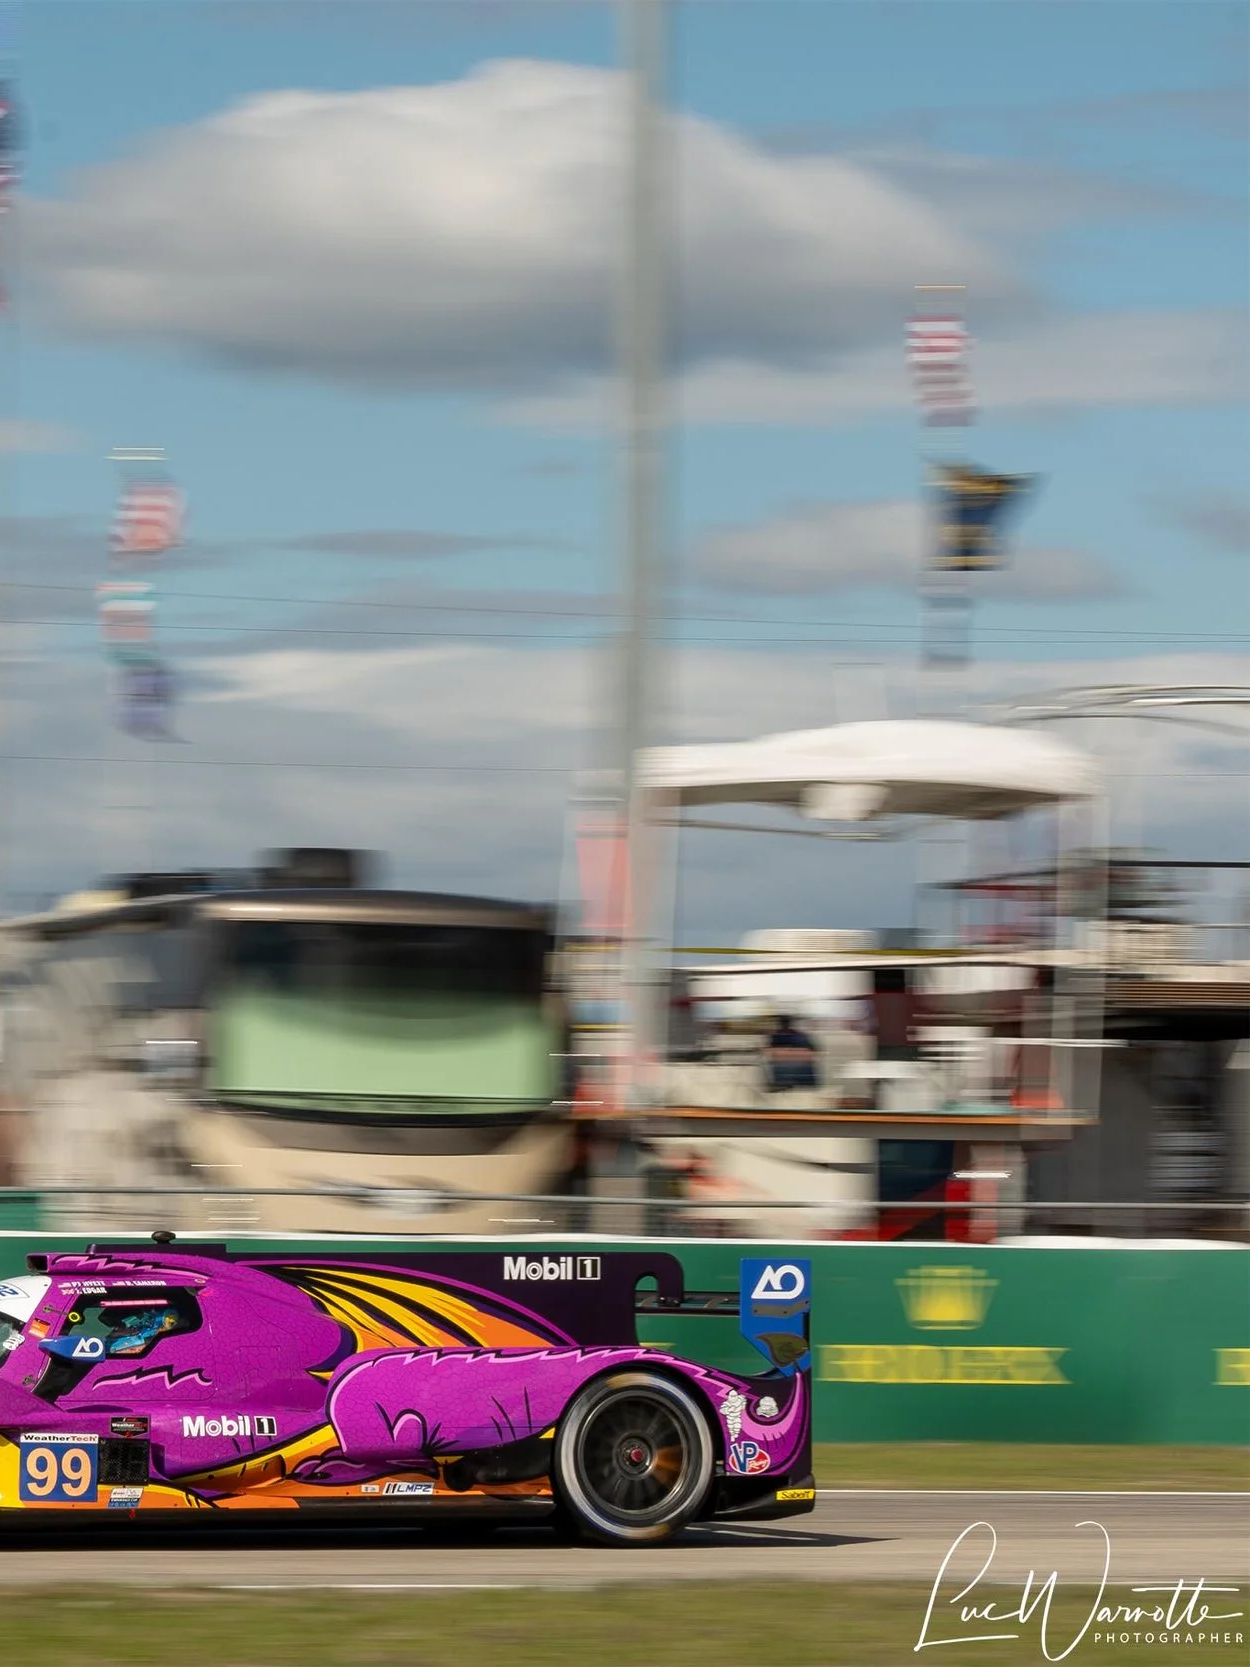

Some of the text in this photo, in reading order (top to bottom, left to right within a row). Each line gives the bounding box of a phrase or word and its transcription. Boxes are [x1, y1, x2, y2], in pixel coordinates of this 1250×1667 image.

[503, 1256, 573, 1280] Mobil
[751, 1264, 805, 1300] AO
[23, 1434, 95, 1442] WeatherTech
[183, 1415, 251, 1437] Mobil
[730, 1441, 759, 1474] VP
[26, 1447, 92, 1497] 99
